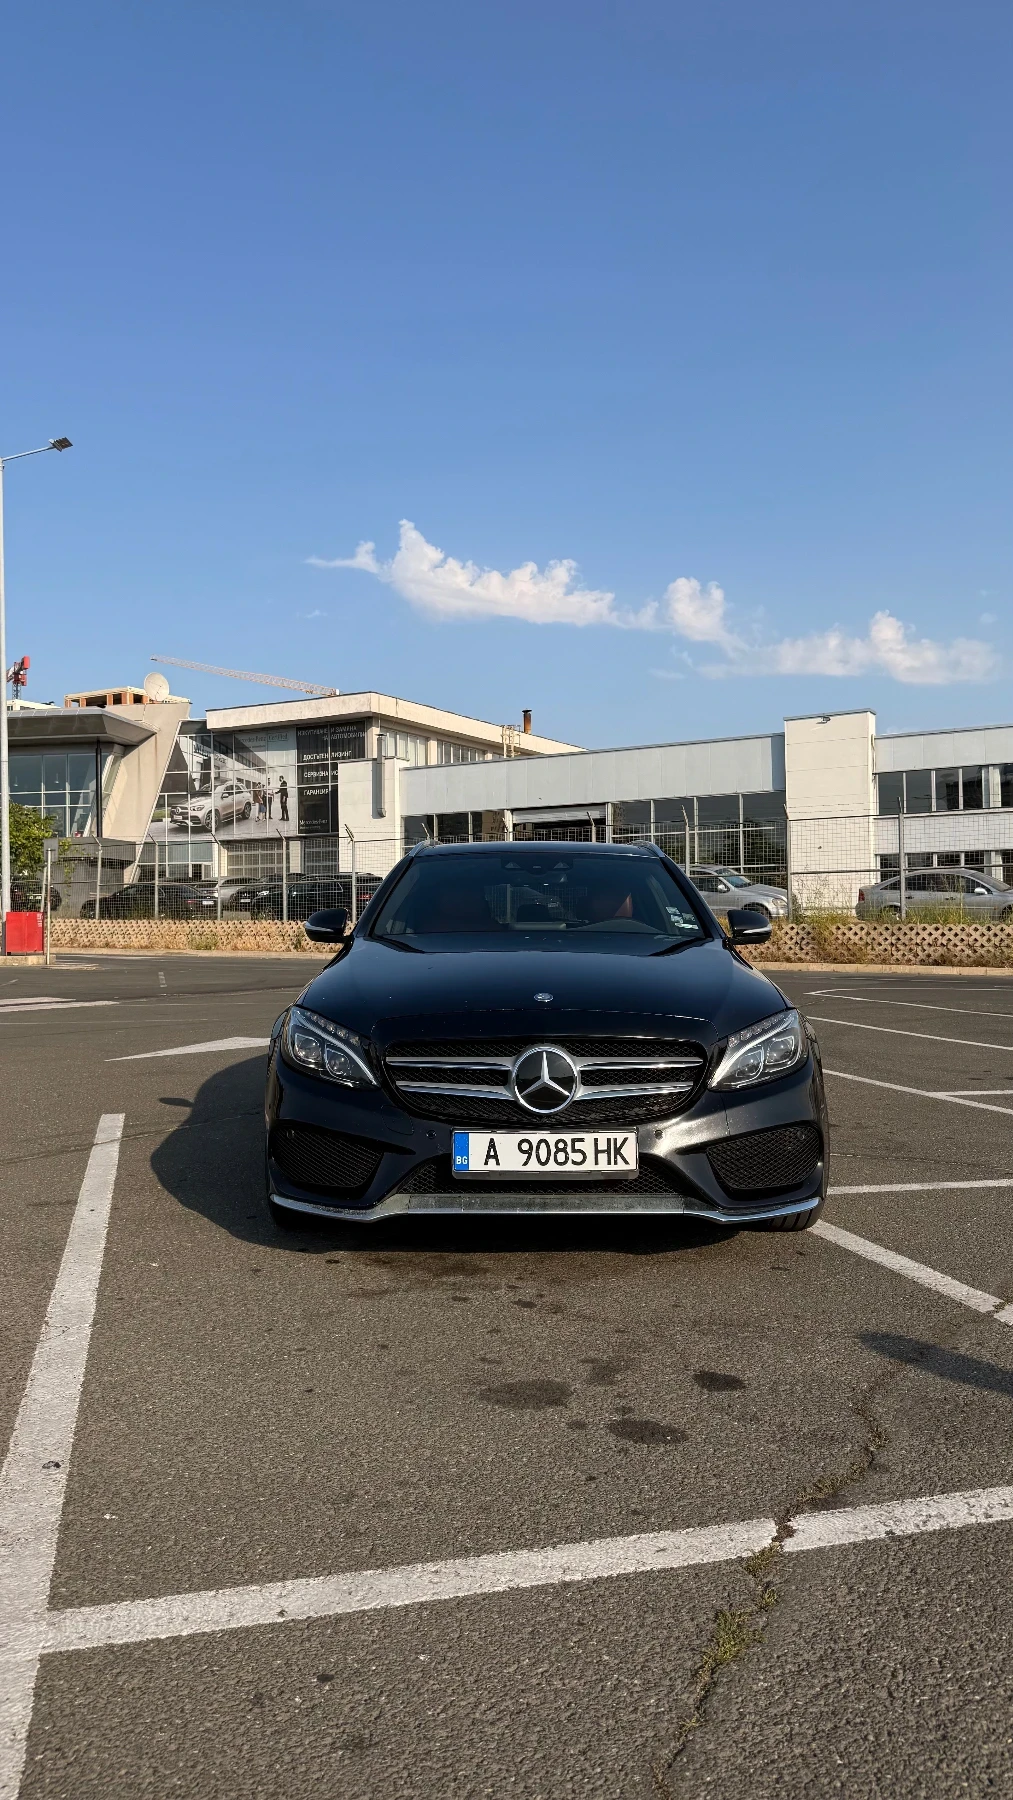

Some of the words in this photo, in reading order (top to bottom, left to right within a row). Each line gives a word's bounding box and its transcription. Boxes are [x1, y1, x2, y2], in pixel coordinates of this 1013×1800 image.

[331, 750, 352, 758] ЛИЗИНГ
[483, 1137, 501, 1166] A
[517, 1137, 588, 1167] 9085
[593, 1137, 631, 1166] HK
[456, 1156, 468, 1165] BG
